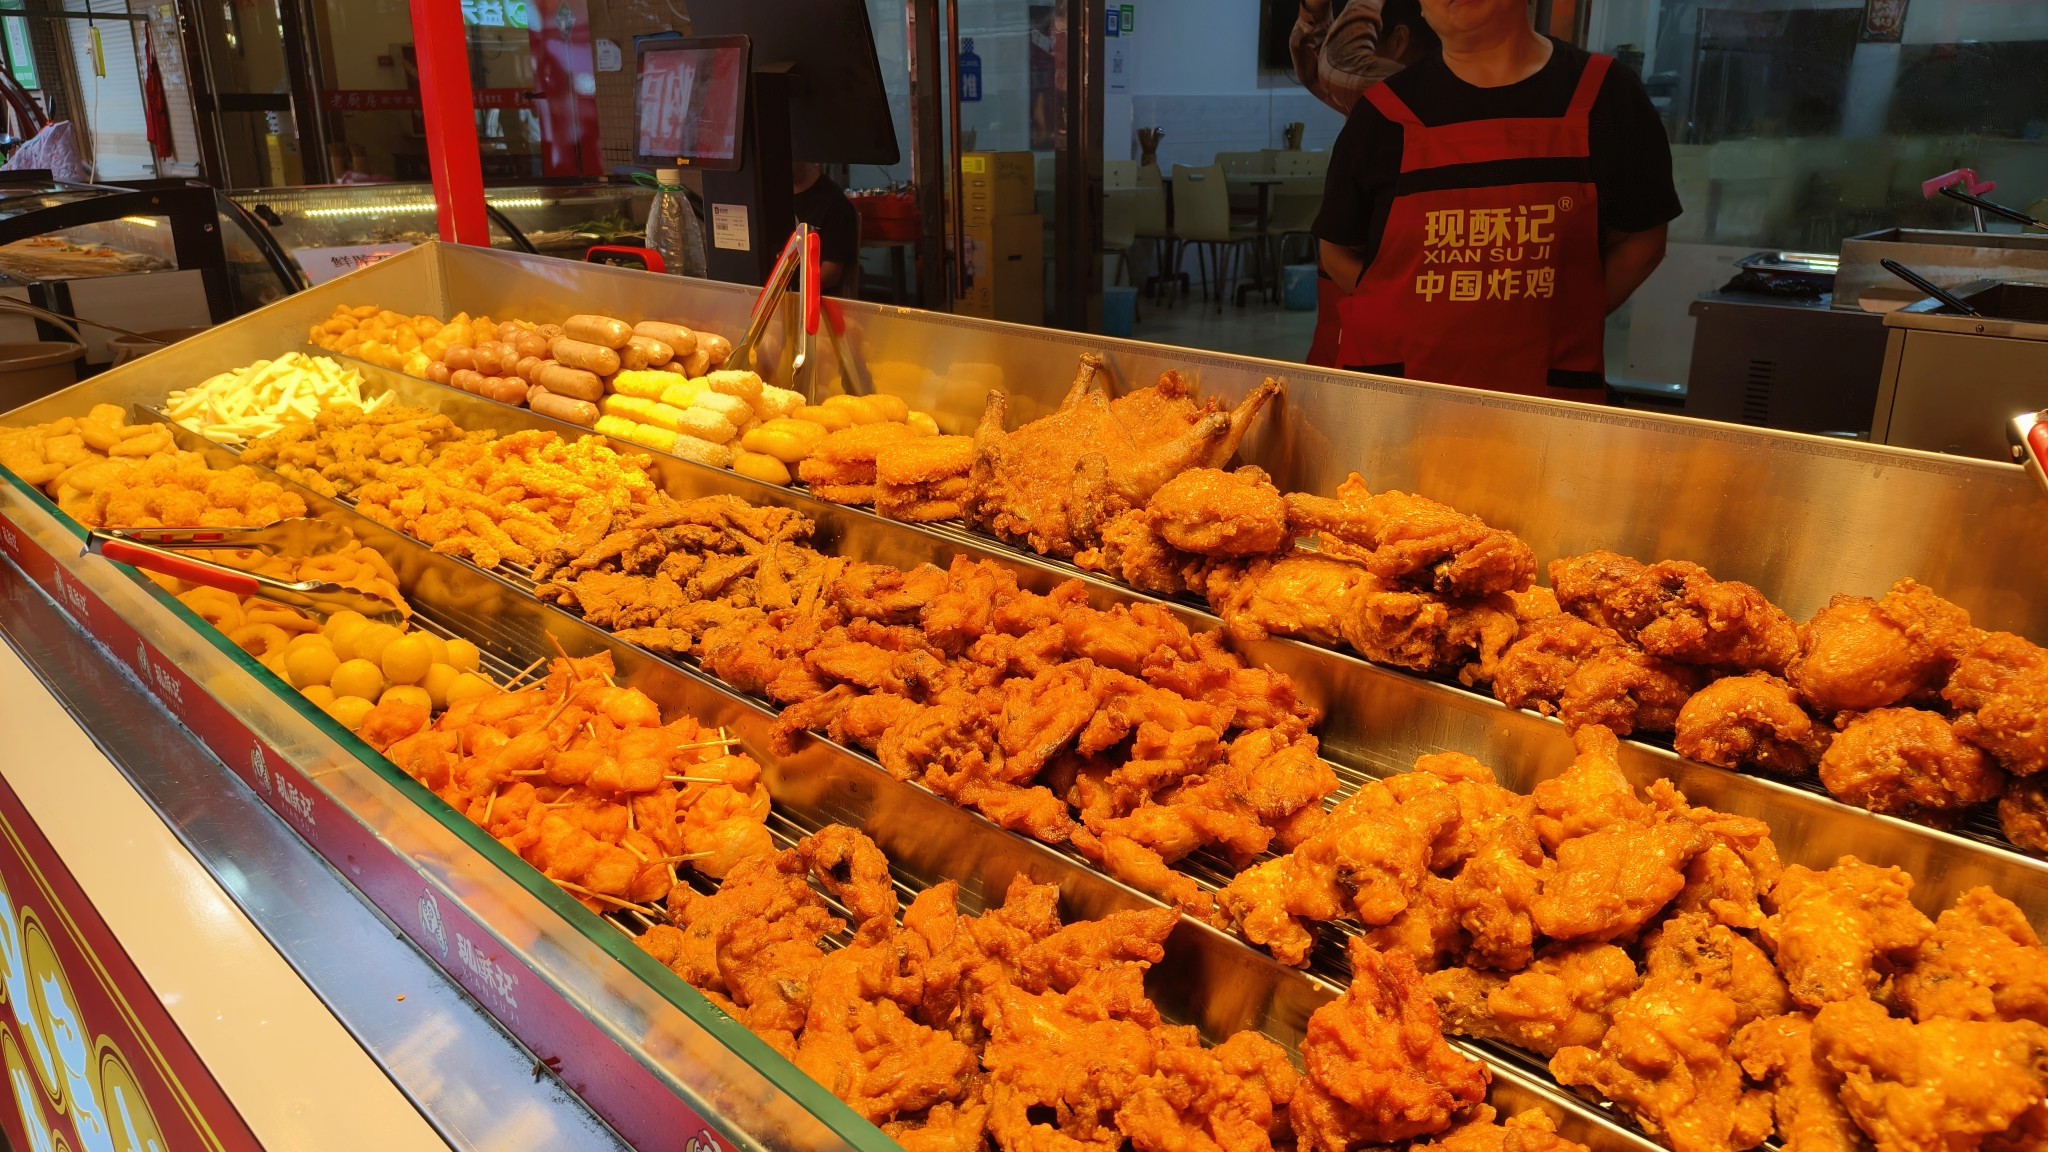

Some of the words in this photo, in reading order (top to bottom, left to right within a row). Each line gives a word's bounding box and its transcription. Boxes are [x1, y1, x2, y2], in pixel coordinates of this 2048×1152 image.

[1423, 204, 1555, 248] 现酥记
[1423, 249, 1481, 264] XIAN
[1489, 247, 1523, 262] SU
[1530, 245, 1550, 260] JI
[1415, 266, 1555, 302] 中国炸鸡
